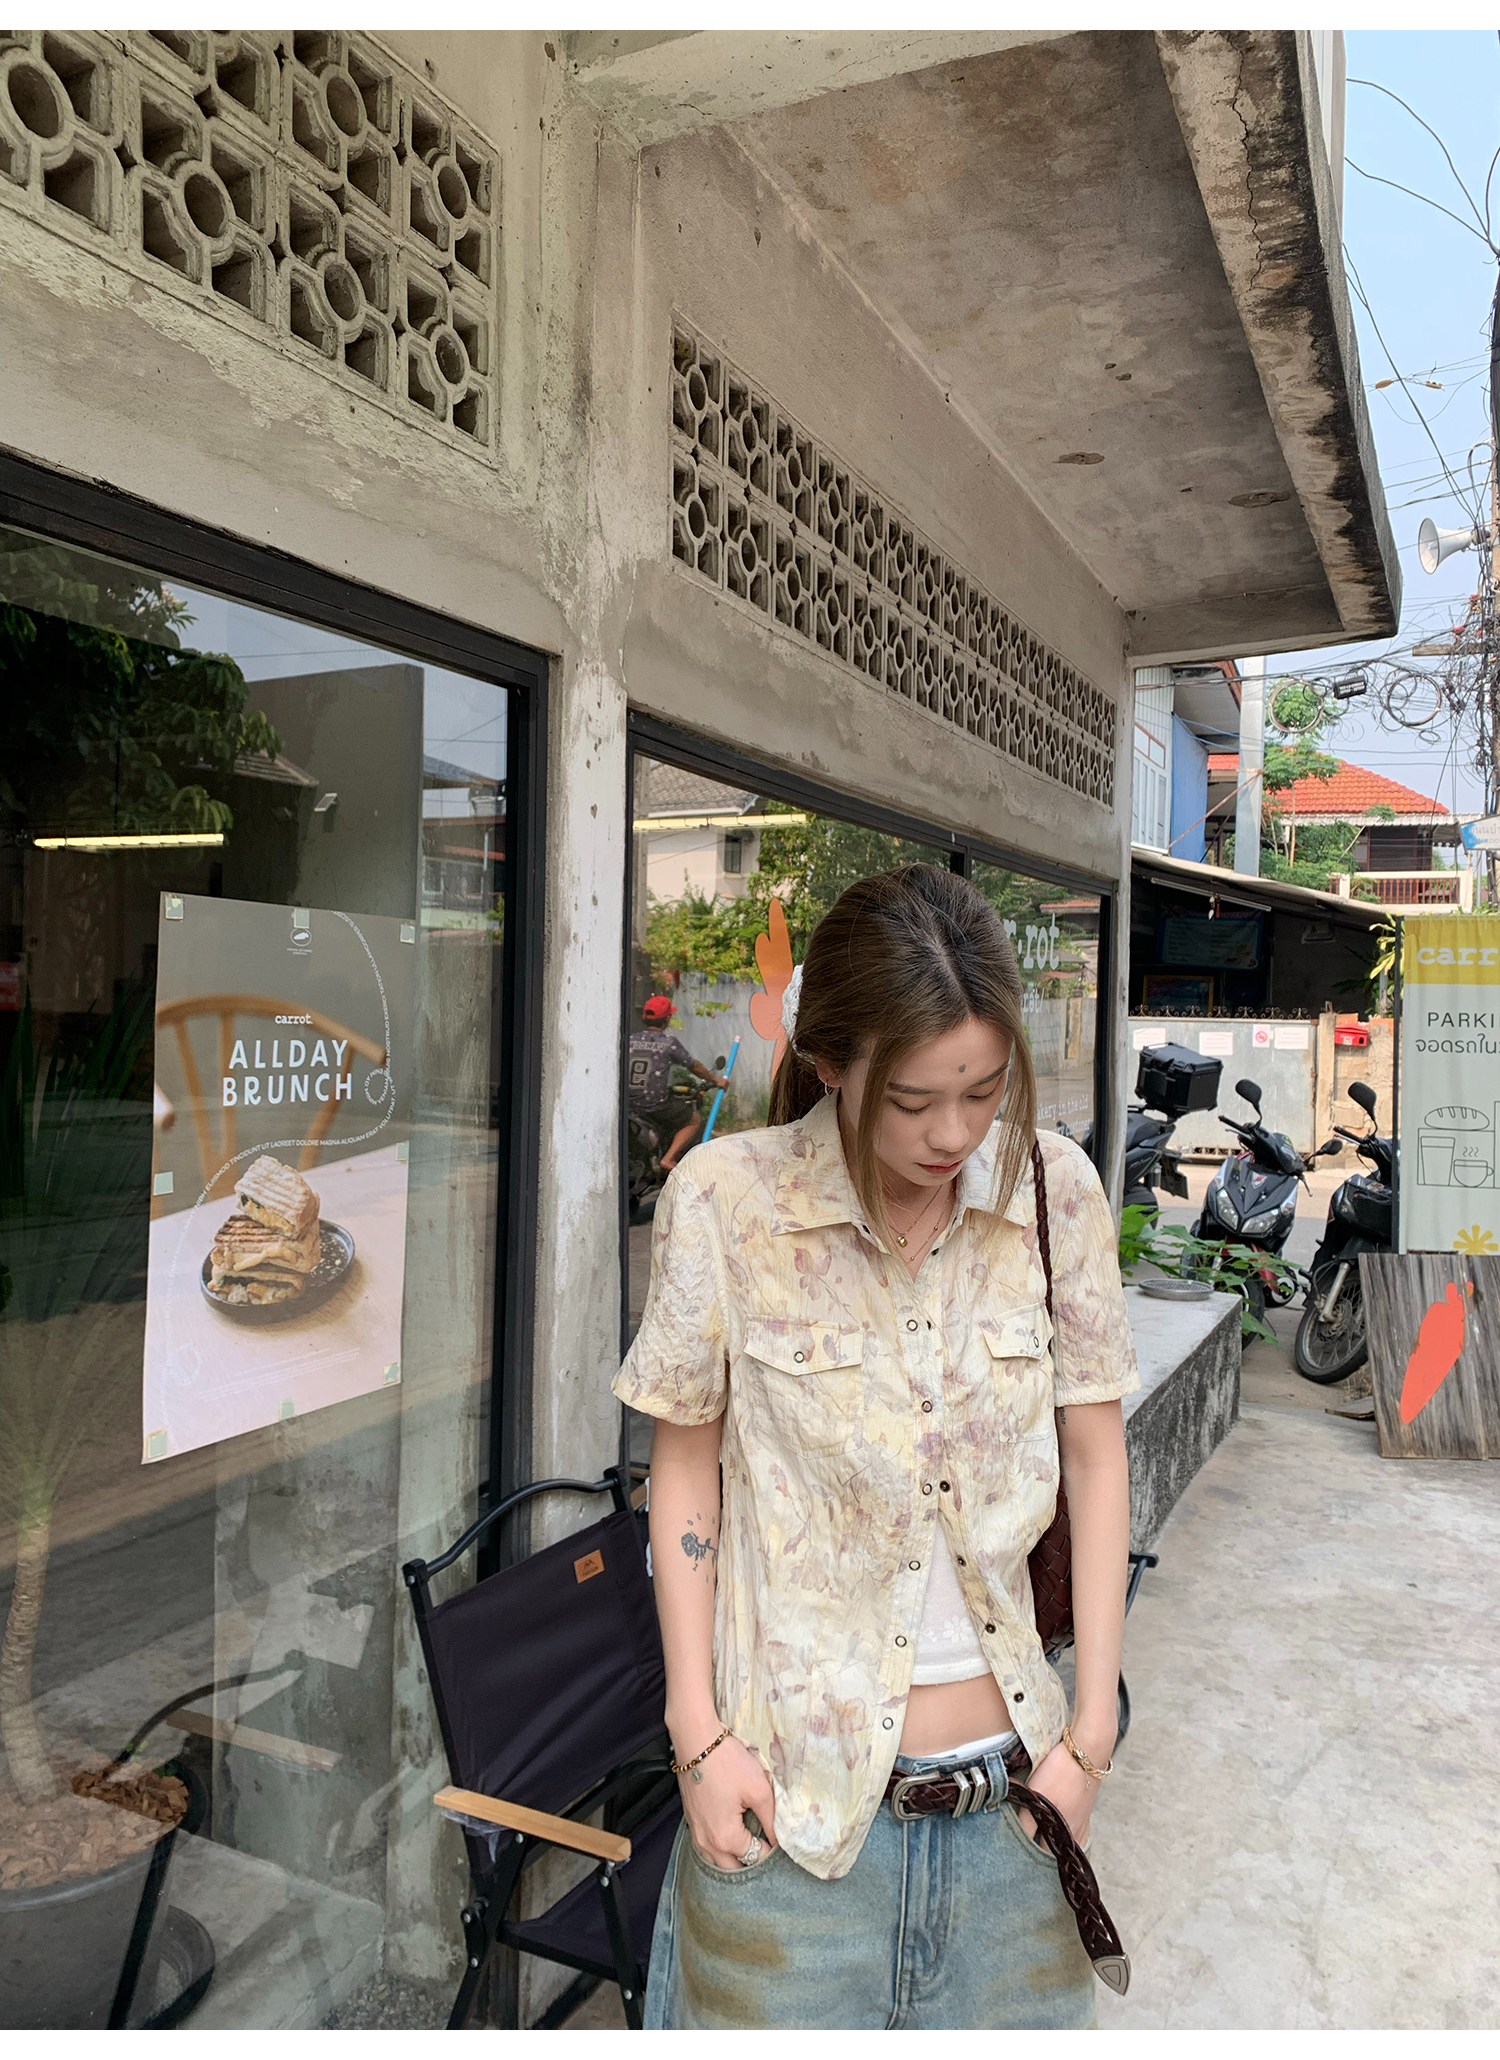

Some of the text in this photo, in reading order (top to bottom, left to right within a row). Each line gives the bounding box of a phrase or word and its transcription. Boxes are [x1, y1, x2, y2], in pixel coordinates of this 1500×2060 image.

[1417, 946, 1500, 966] carr
[1427, 1012, 1500, 1028] PARKI
[228, 1039, 348, 1069] ALLDAY
[1415, 1033, 1500, 1054] จอดรถใน
[222, 1072, 352, 1107] BRUNCH
[261, 1141, 270, 1150] UT
[296, 1139, 320, 1147] DOLORE
[320, 1138, 341, 1146] MAGNA
[365, 1126, 380, 1139] ERAT
